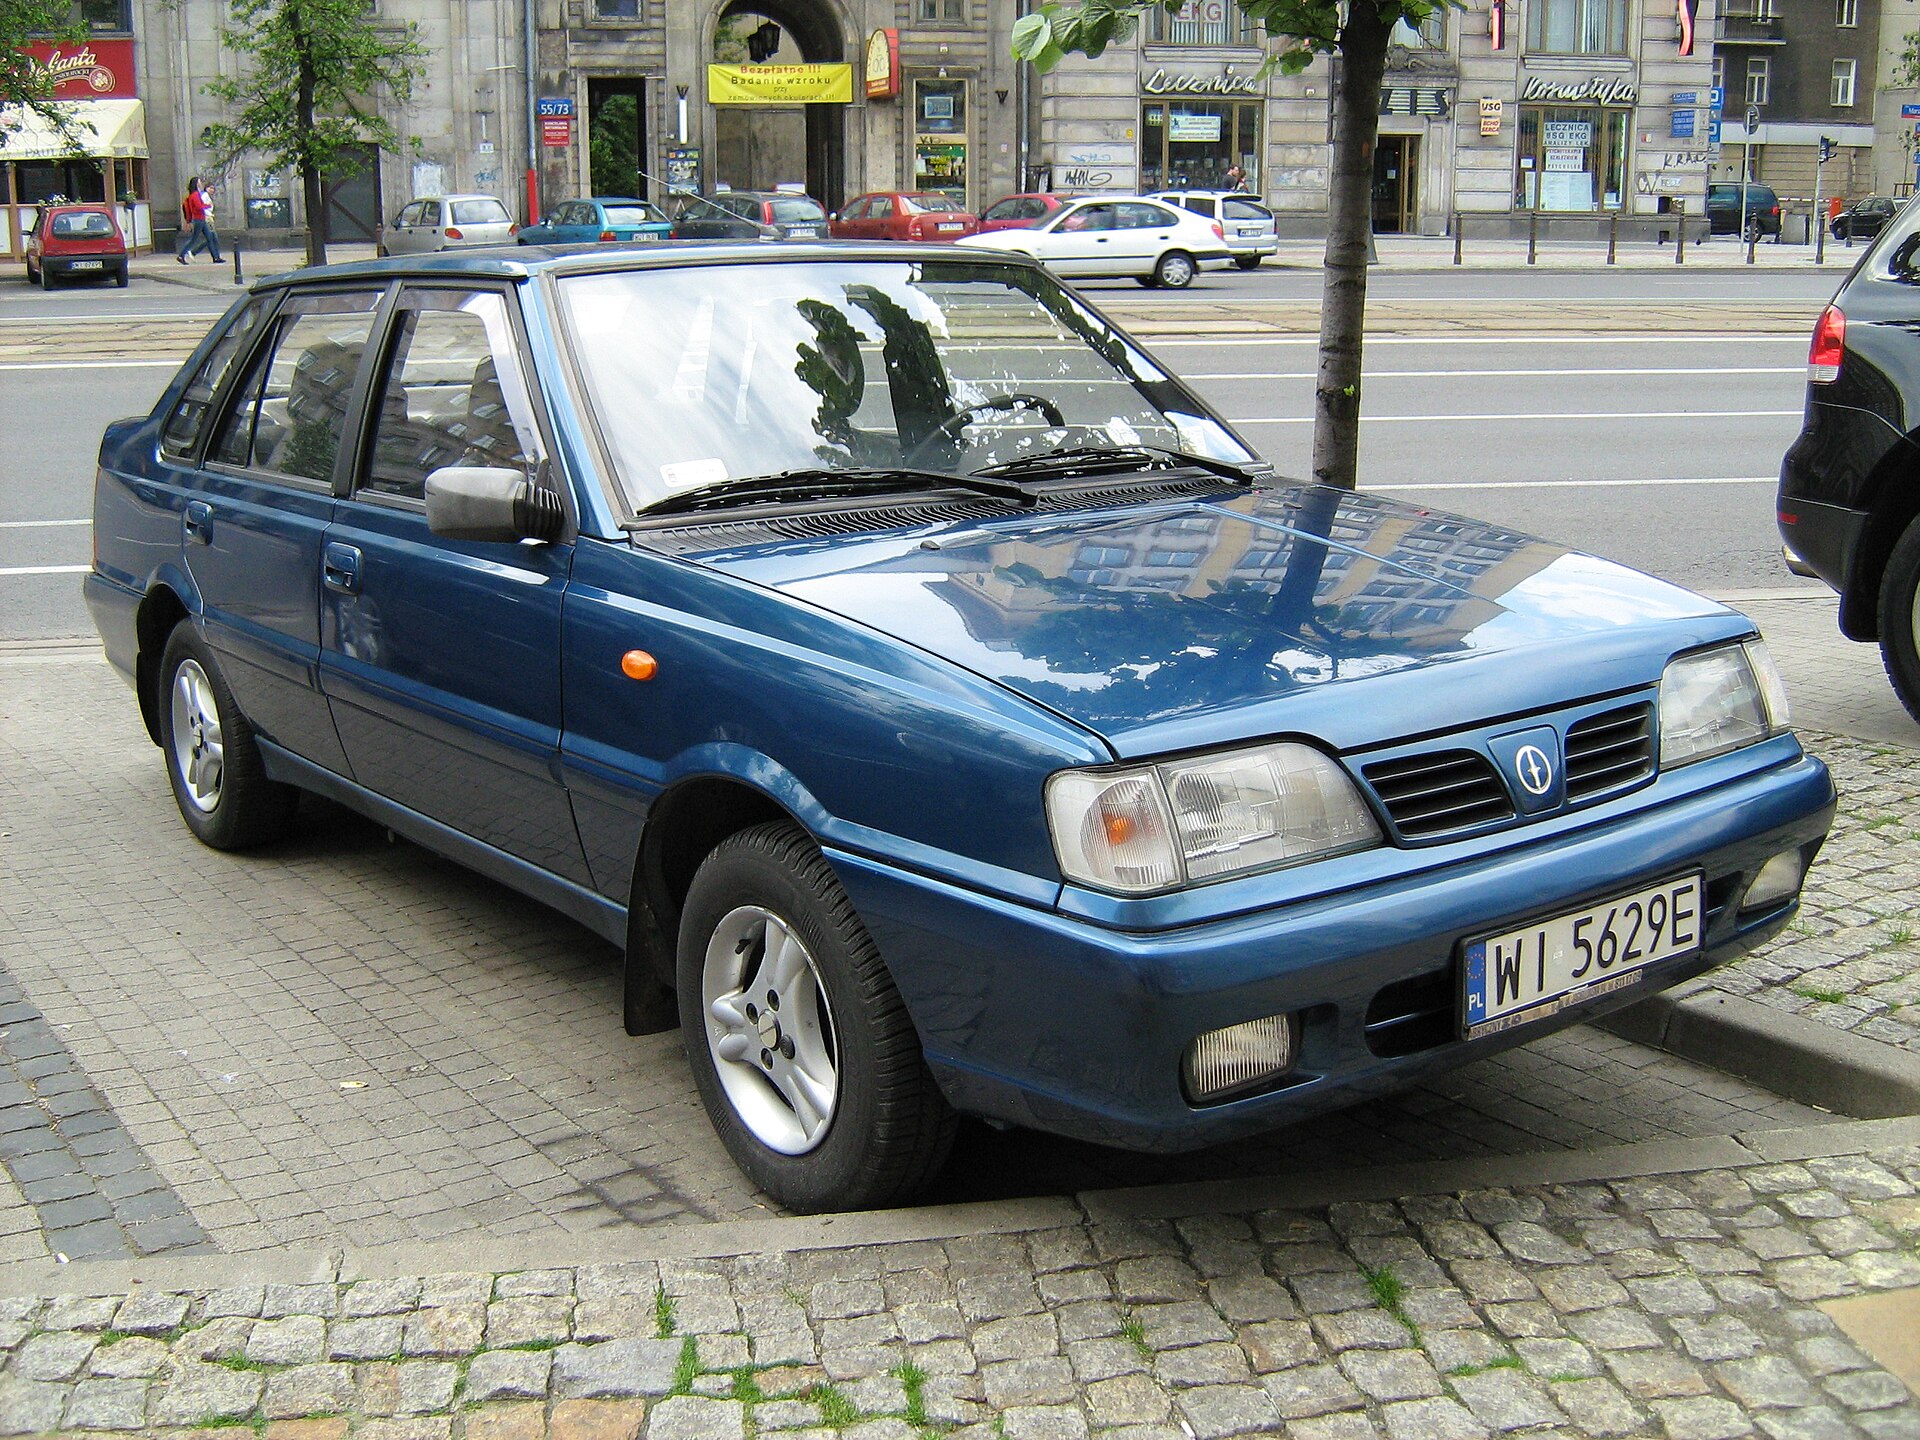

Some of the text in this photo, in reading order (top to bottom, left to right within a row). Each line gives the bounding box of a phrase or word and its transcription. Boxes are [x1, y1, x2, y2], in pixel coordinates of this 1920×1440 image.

[741, 65, 804, 75] Bezpłatne
[731, 76, 782, 84] Badanie
[1145, 65, 1258, 94] Lecznica
[541, 103, 569, 115] 55/73
[1496, 931, 1545, 1005] WI
[1571, 884, 1694, 978] 5629E
[1469, 994, 1483, 1011] PL
